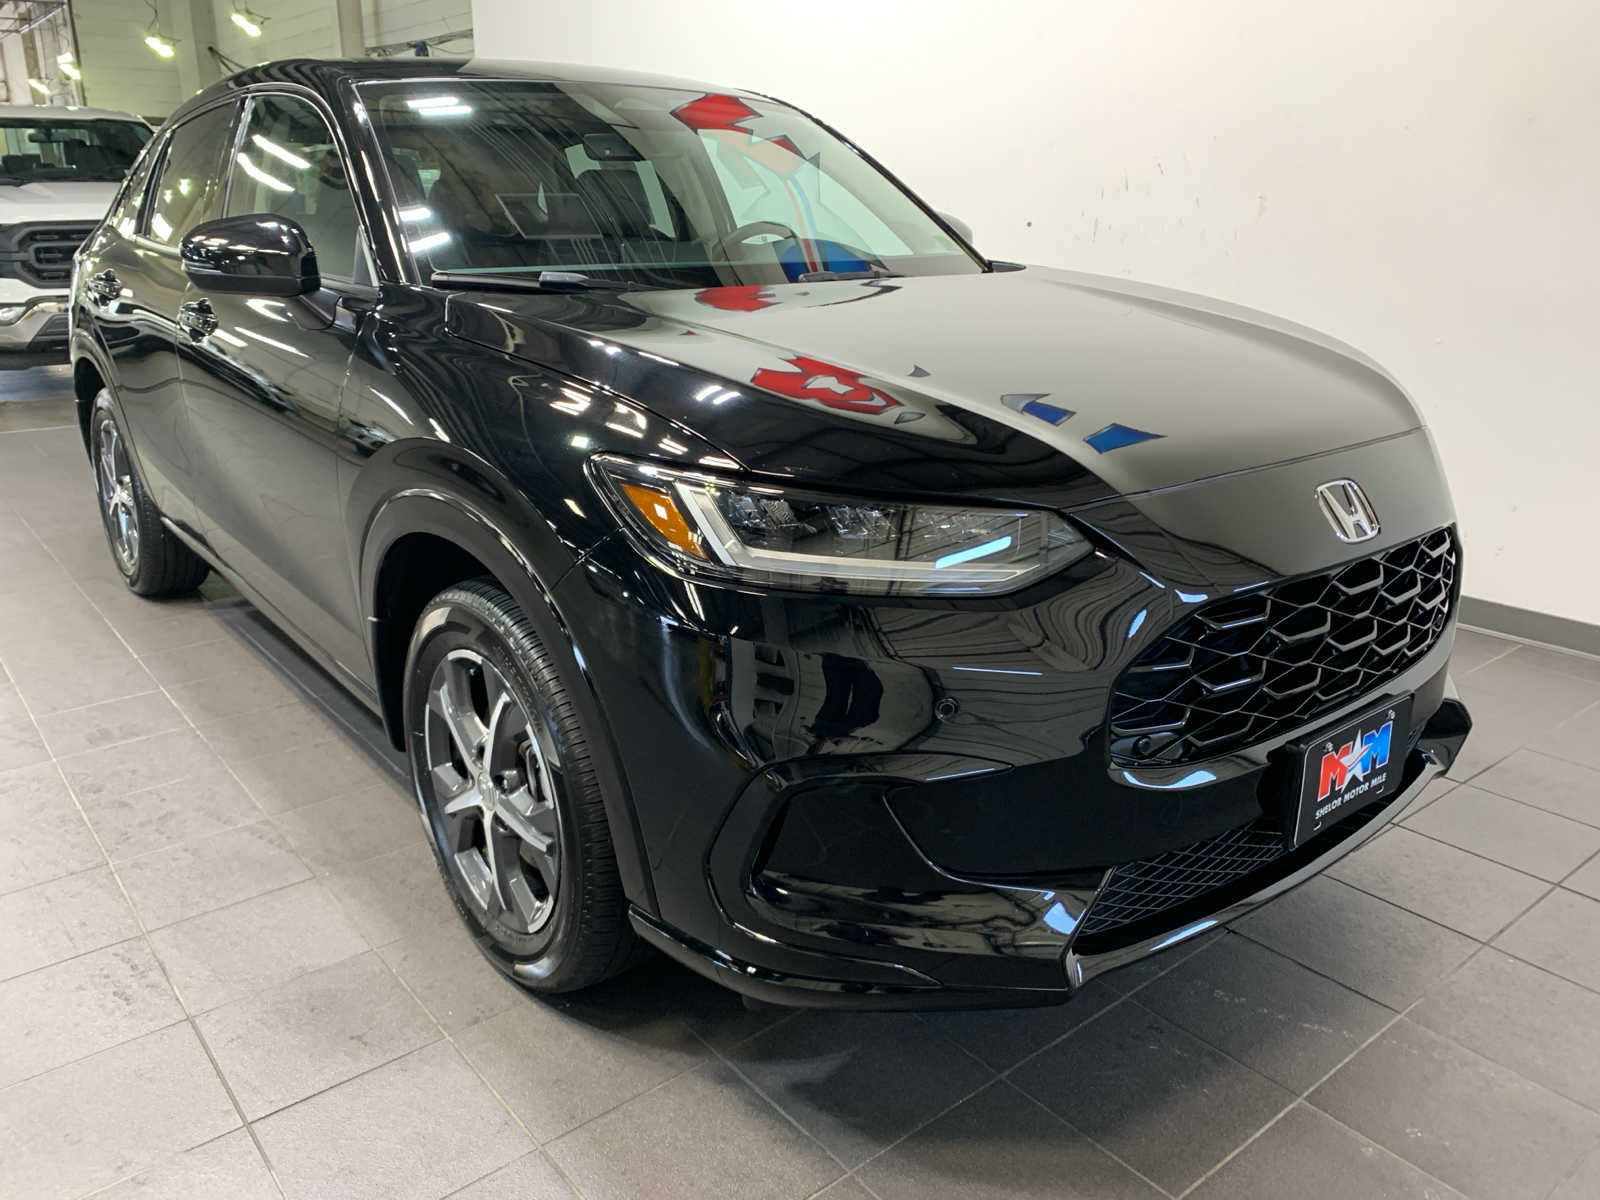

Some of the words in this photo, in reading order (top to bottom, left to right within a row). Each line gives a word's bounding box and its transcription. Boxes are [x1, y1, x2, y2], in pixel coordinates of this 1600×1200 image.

[1315, 797, 1342, 820] SHELOR
[1343, 782, 1370, 804] MOTOR
[1370, 772, 1388, 789] MILE
